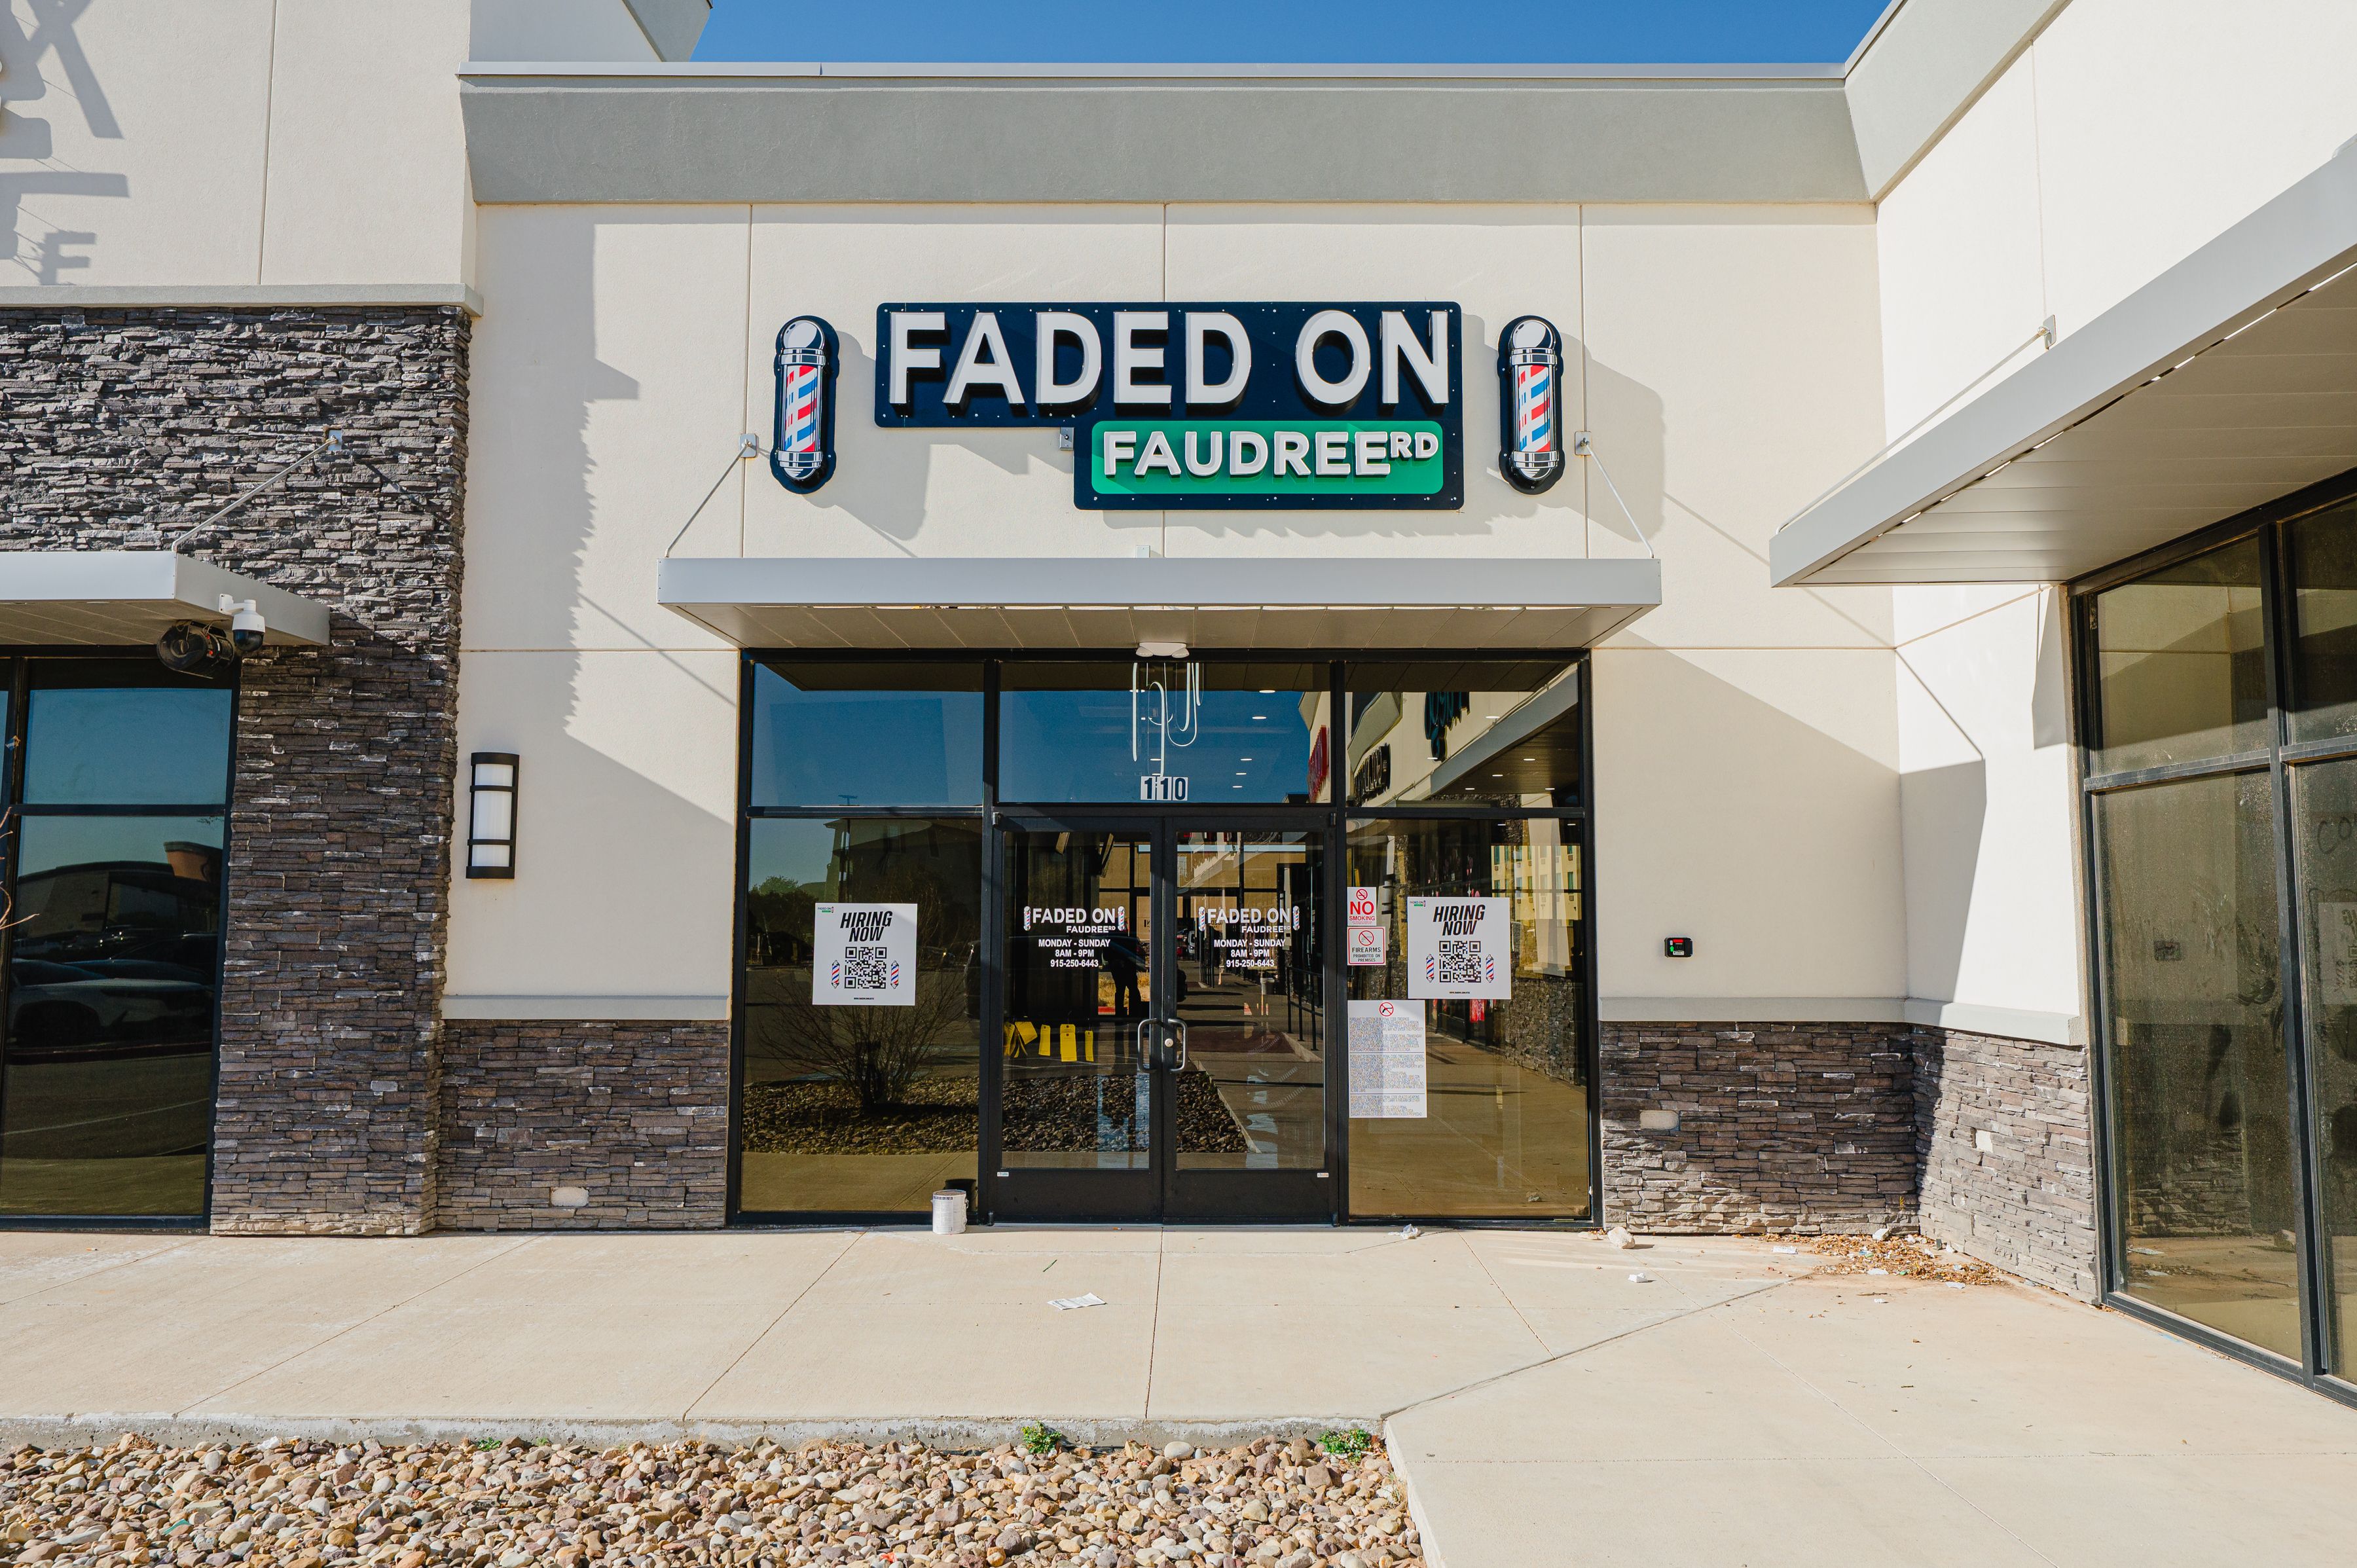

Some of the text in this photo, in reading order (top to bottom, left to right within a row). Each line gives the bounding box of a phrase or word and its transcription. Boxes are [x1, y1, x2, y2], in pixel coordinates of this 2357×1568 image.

[889, 309, 1449, 407] FADED ON
[1144, 777, 1186, 800] 110
[1207, 908, 1290, 923] FADED ON
[1350, 901, 1374, 915] NO
[1433, 904, 1486, 922] HIRING
[840, 911, 893, 928] HIRING
[1032, 908, 1115, 924] FADED ON
[849, 926, 885, 942] NOW
[1442, 920, 1478, 936] NOW
[1038, 939, 1072, 947] MONDAY
[1078, 939, 1111, 947] SUNDAY
[1214, 939, 1247, 947] MONDAY
[1254, 939, 1285, 947] SUNDAY
[1254, 949, 1270, 957] 9PM
[1050, 959, 1099, 968] 915-250-6443
[1226, 959, 1275, 968] 915-250-6443
